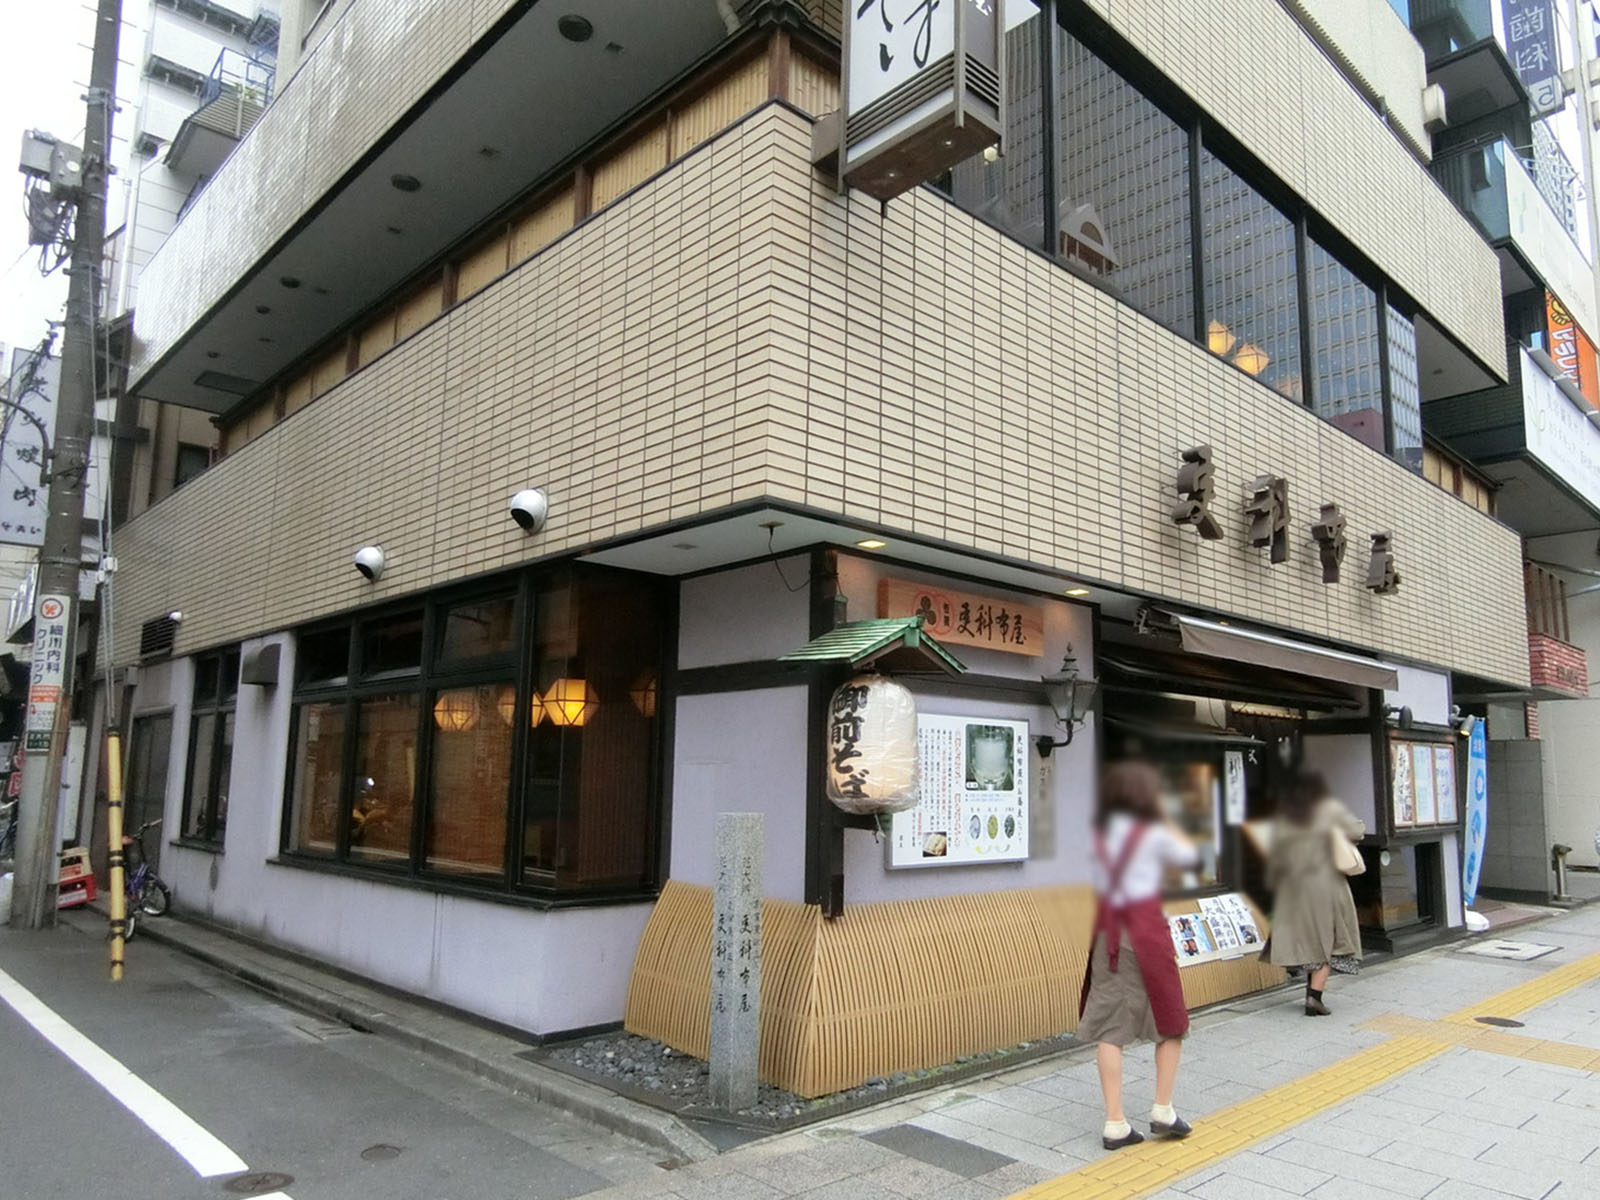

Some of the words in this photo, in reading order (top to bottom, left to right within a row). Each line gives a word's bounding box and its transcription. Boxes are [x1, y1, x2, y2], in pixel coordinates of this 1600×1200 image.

[1171, 444, 1401, 596] 更科布屋
[46, 625, 63, 674] 細川内科
[957, 602, 1027, 645] 更科布屋
[33, 628, 47, 684] クリニック
[831, 683, 871, 799] 御前そば
